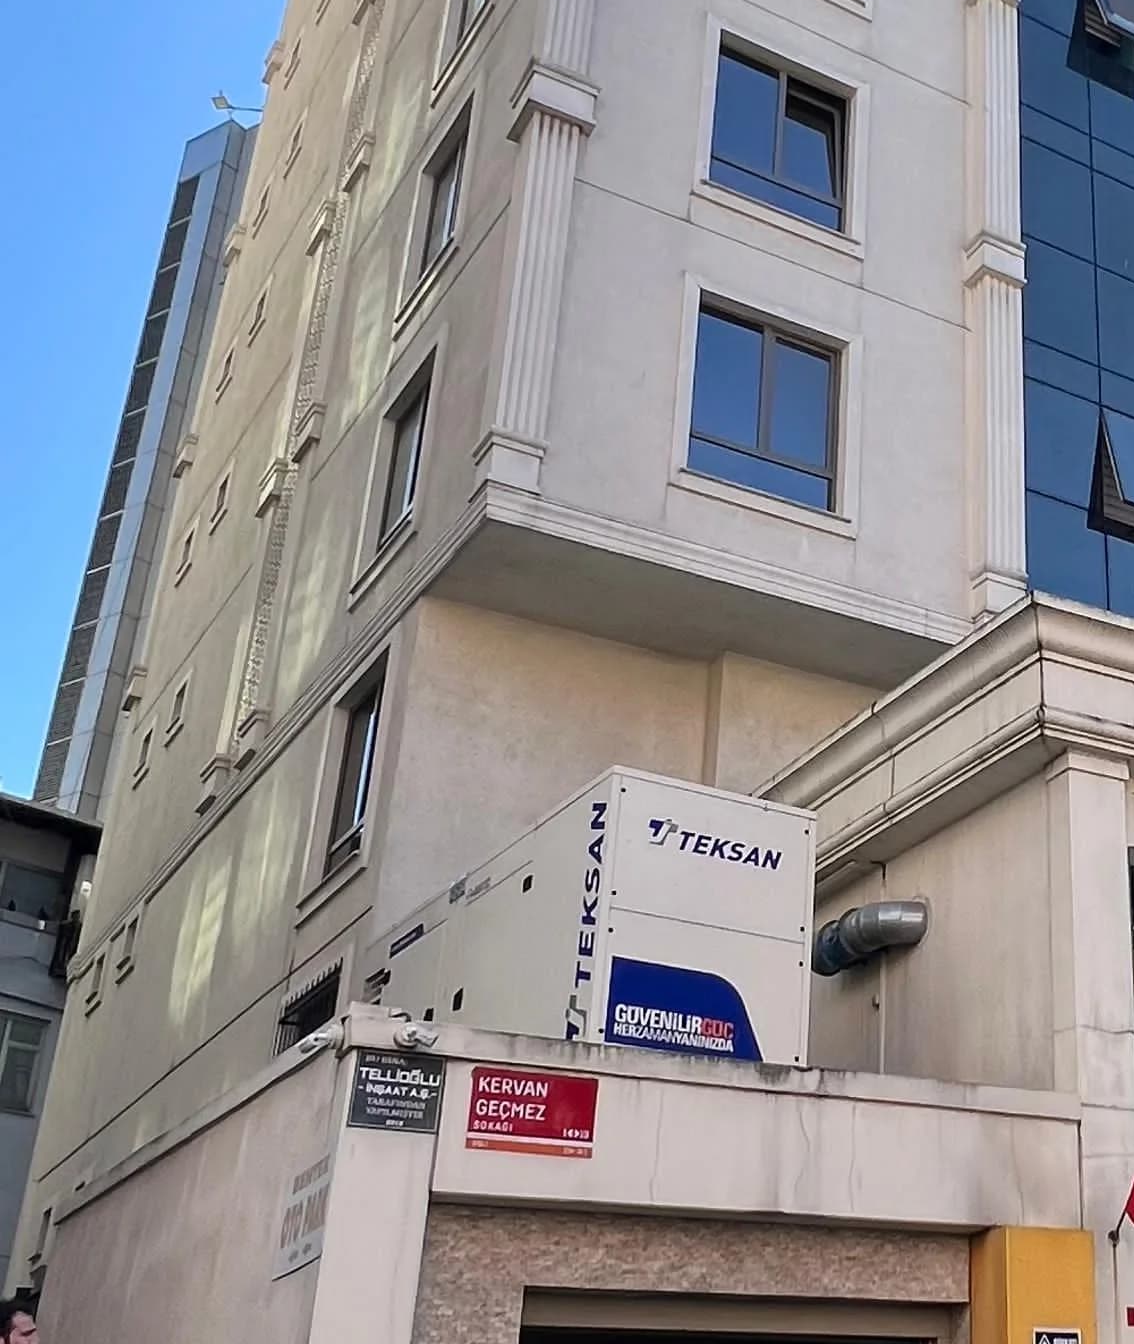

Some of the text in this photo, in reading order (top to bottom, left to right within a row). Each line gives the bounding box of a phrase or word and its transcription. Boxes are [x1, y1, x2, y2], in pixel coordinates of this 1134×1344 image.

[680, 831, 782, 869] TEKSAN
[574, 802, 607, 988] TEKSAN
[360, 1067, 440, 1087] TELLİOĞLU
[478, 1076, 549, 1098] KERVAN
[476, 1098, 546, 1120] GEÇMEZ
[472, 1119, 513, 1132] SOKAĞI
